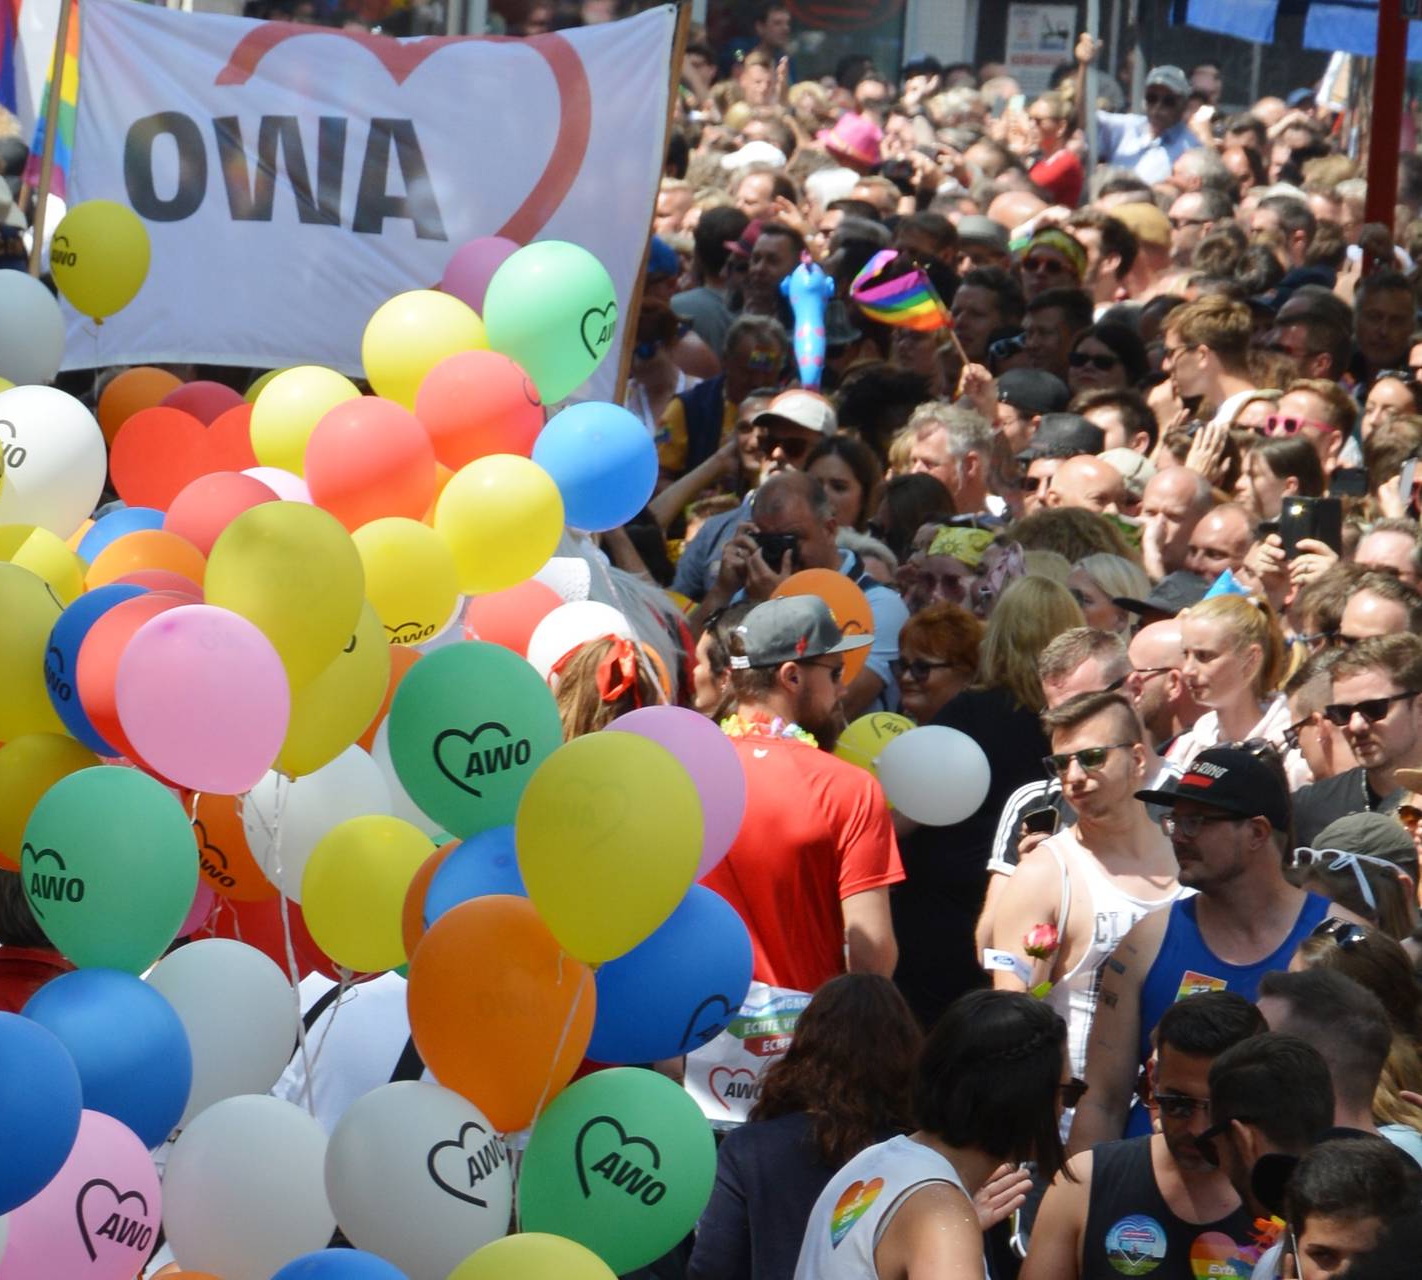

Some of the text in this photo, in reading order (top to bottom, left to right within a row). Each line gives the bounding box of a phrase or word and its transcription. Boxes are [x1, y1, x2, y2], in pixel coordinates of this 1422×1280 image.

[389, 624, 435, 645] AWO
[464, 738, 531, 778] AWO
[31, 872, 85, 902] AWO
[590, 1151, 667, 1206] AWO
[95, 1211, 153, 1252] AWO
